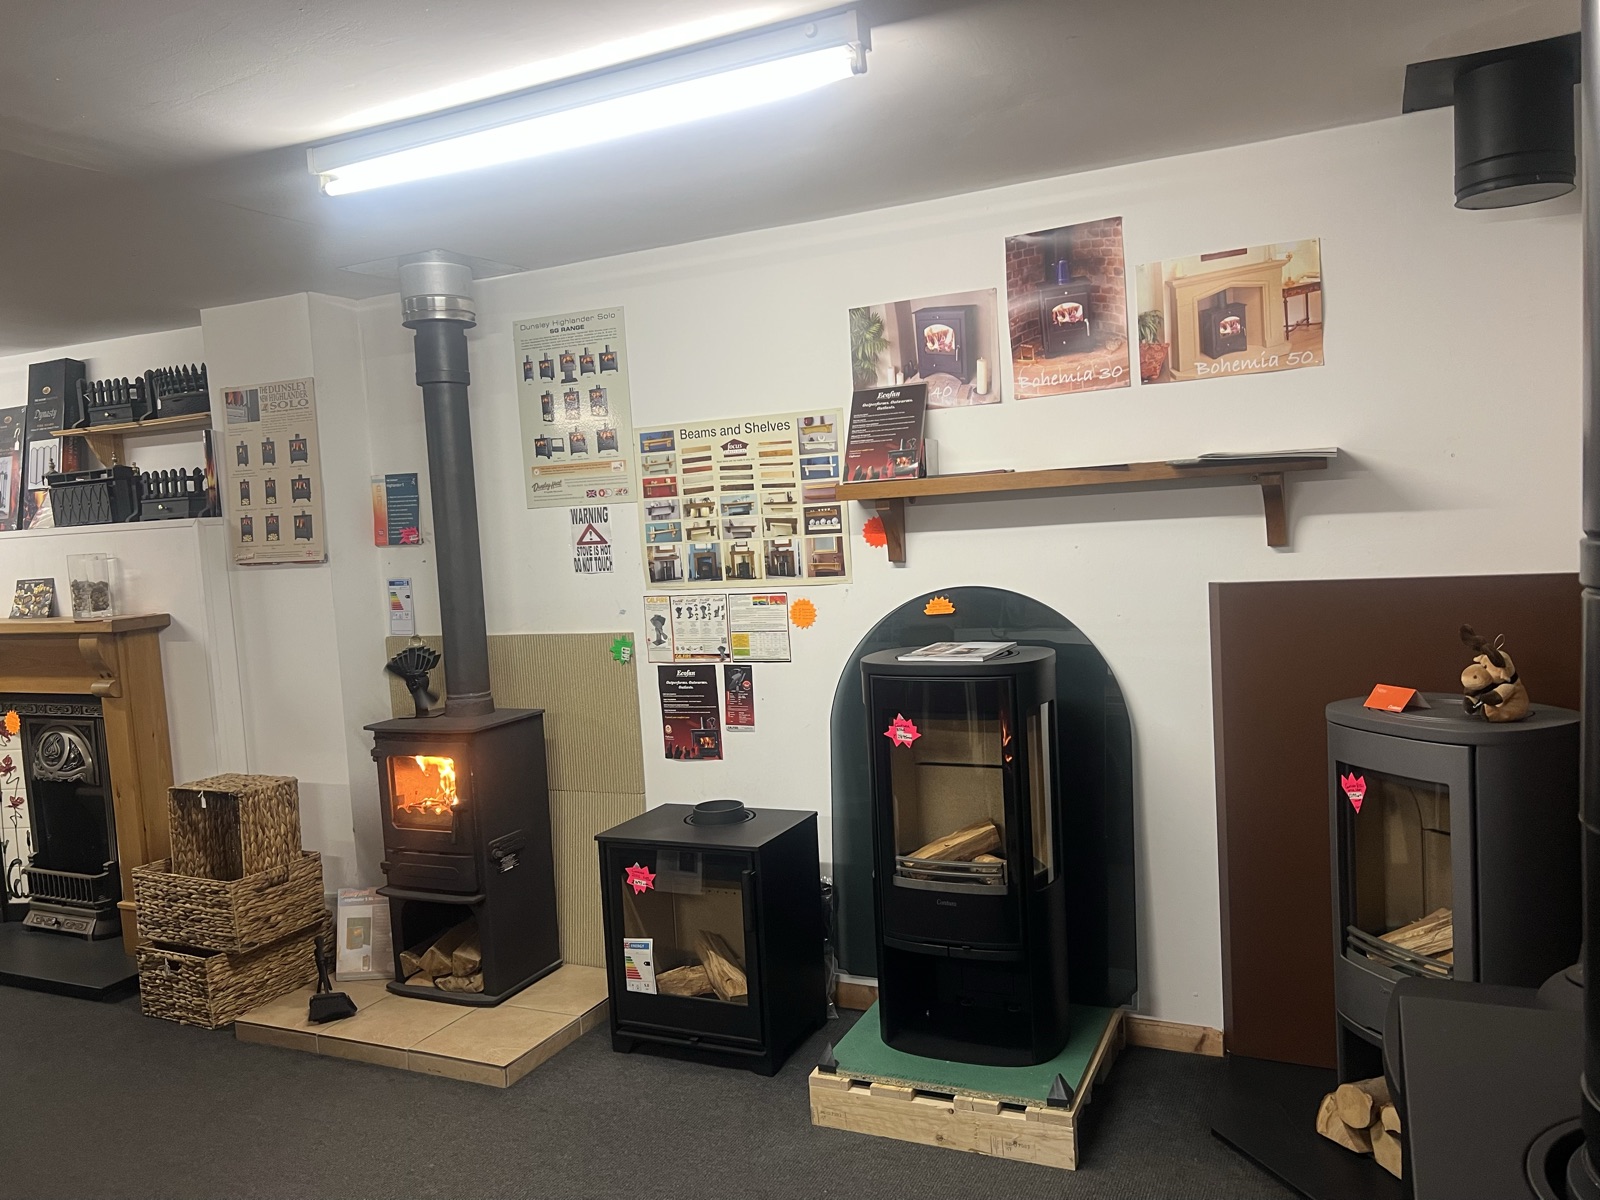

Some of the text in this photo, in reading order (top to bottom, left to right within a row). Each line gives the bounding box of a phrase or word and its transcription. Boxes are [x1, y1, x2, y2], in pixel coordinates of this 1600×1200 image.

[520, 312, 616, 331] Dunsley Highlander Solo
[560, 324, 585, 333] RANGE
[1194, 350, 1279, 376] Bohemia
[1017, 365, 1123, 389] Bohemia 30
[260, 381, 308, 394] THE DUNSLEY
[930, 386, 952, 398] 40
[268, 390, 308, 402] HIGHLANDER
[876, 390, 900, 400] Ecofan
[270, 398, 310, 410] SOLO
[34, 409, 57, 421] Dynasty
[680, 420, 791, 440] Beams and Shelves
[727, 443, 743, 451] focus
[570, 506, 609, 525] WARNING
[576, 545, 611, 556] STOVE IS HOT
[574, 556, 613, 572] DO NOT TOUCH
